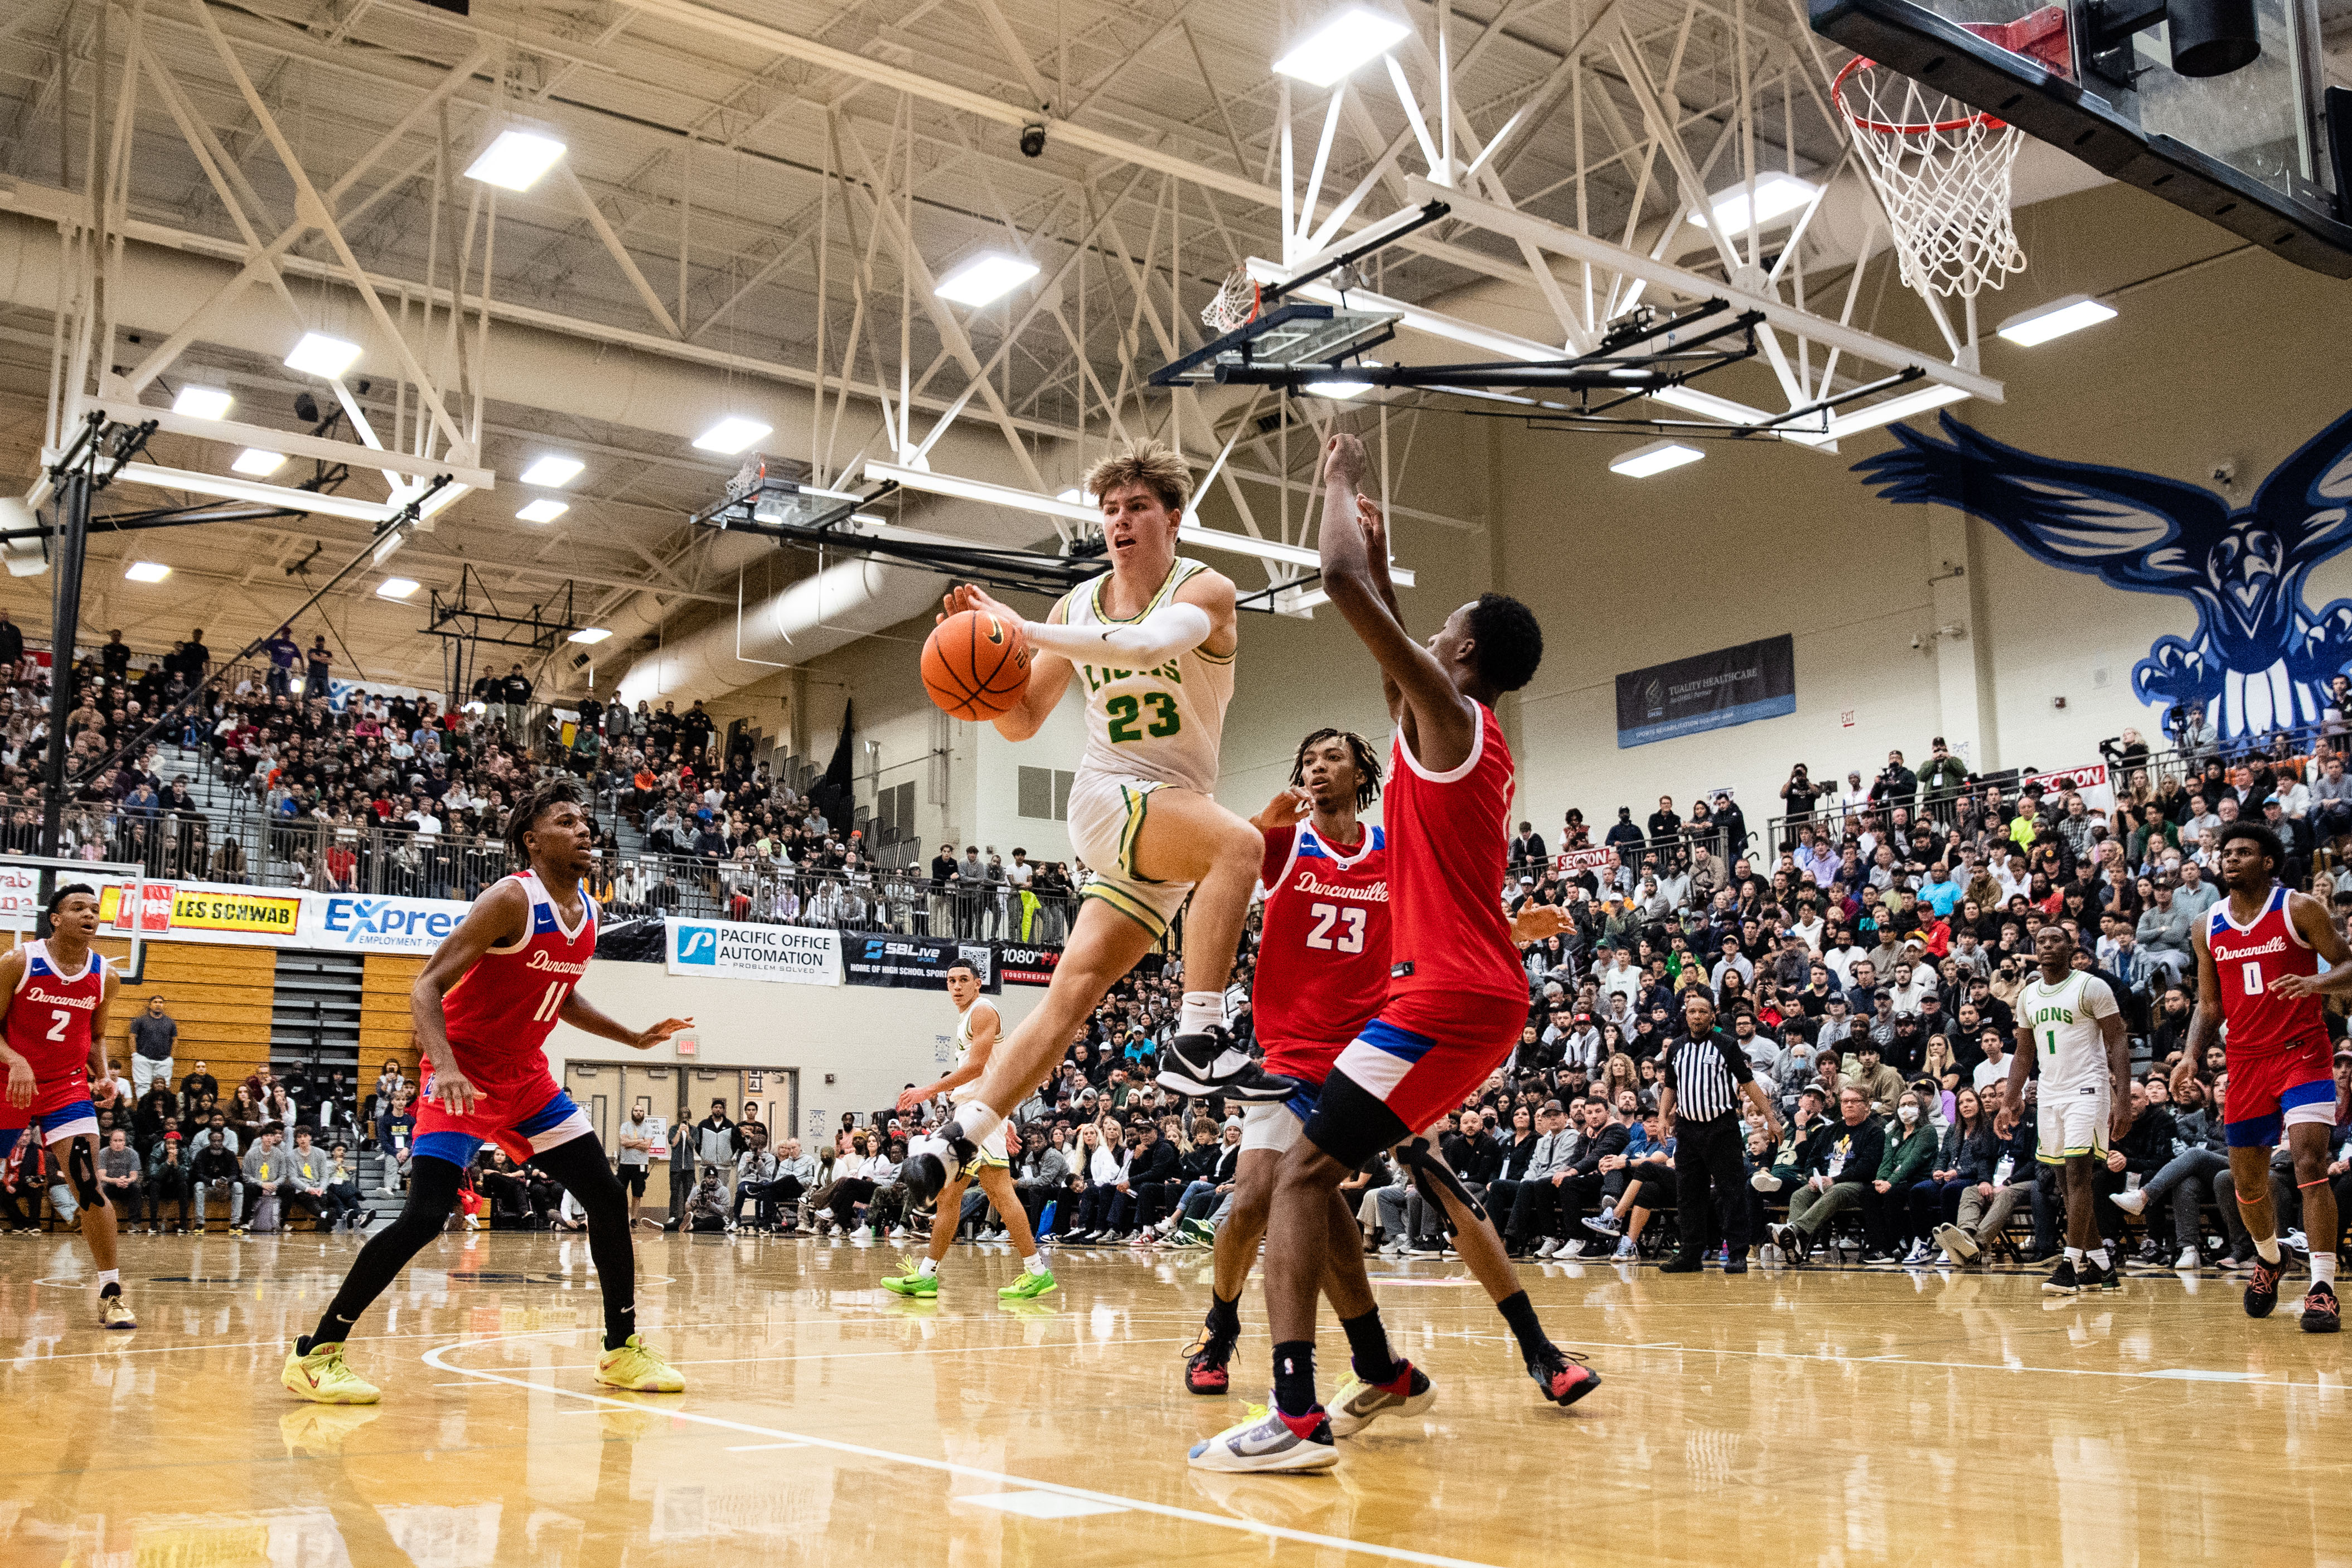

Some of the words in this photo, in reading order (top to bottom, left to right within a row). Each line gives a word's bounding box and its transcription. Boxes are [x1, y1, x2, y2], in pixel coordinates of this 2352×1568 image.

[1669, 680, 1701, 695] TUALITY
[1703, 668, 1758, 687] HEALTHCARE
[1106, 692, 1180, 743] 23
[1841, 710, 1855, 723] EXIT
[1294, 872, 1390, 902] Duncanville
[176, 901, 207, 918] LES
[211, 903, 289, 923] SCHWAB
[721, 929, 776, 945] PACIFIC
[782, 934, 831, 950] OFFICE
[1306, 903, 1366, 953] 23
[359, 936, 422, 946] EMPLOYMENT
[2215, 936, 2287, 961] Duncanville
[720, 947, 823, 966] AUTOMATION
[1001, 948, 1035, 964] 1080
[1042, 952, 1059, 965] FA
[850, 964, 870, 972] HOME
[871, 965, 880, 973] OF
[882, 966, 898, 974] HIGH
[899, 967, 925, 976] SCHOOL
[927, 969, 947, 978] SPORT
[2242, 961, 2264, 995] 0
[533, 981, 568, 1022] 11
[46, 1010, 71, 1042] 2
[2046, 1030, 2056, 1054] 1
